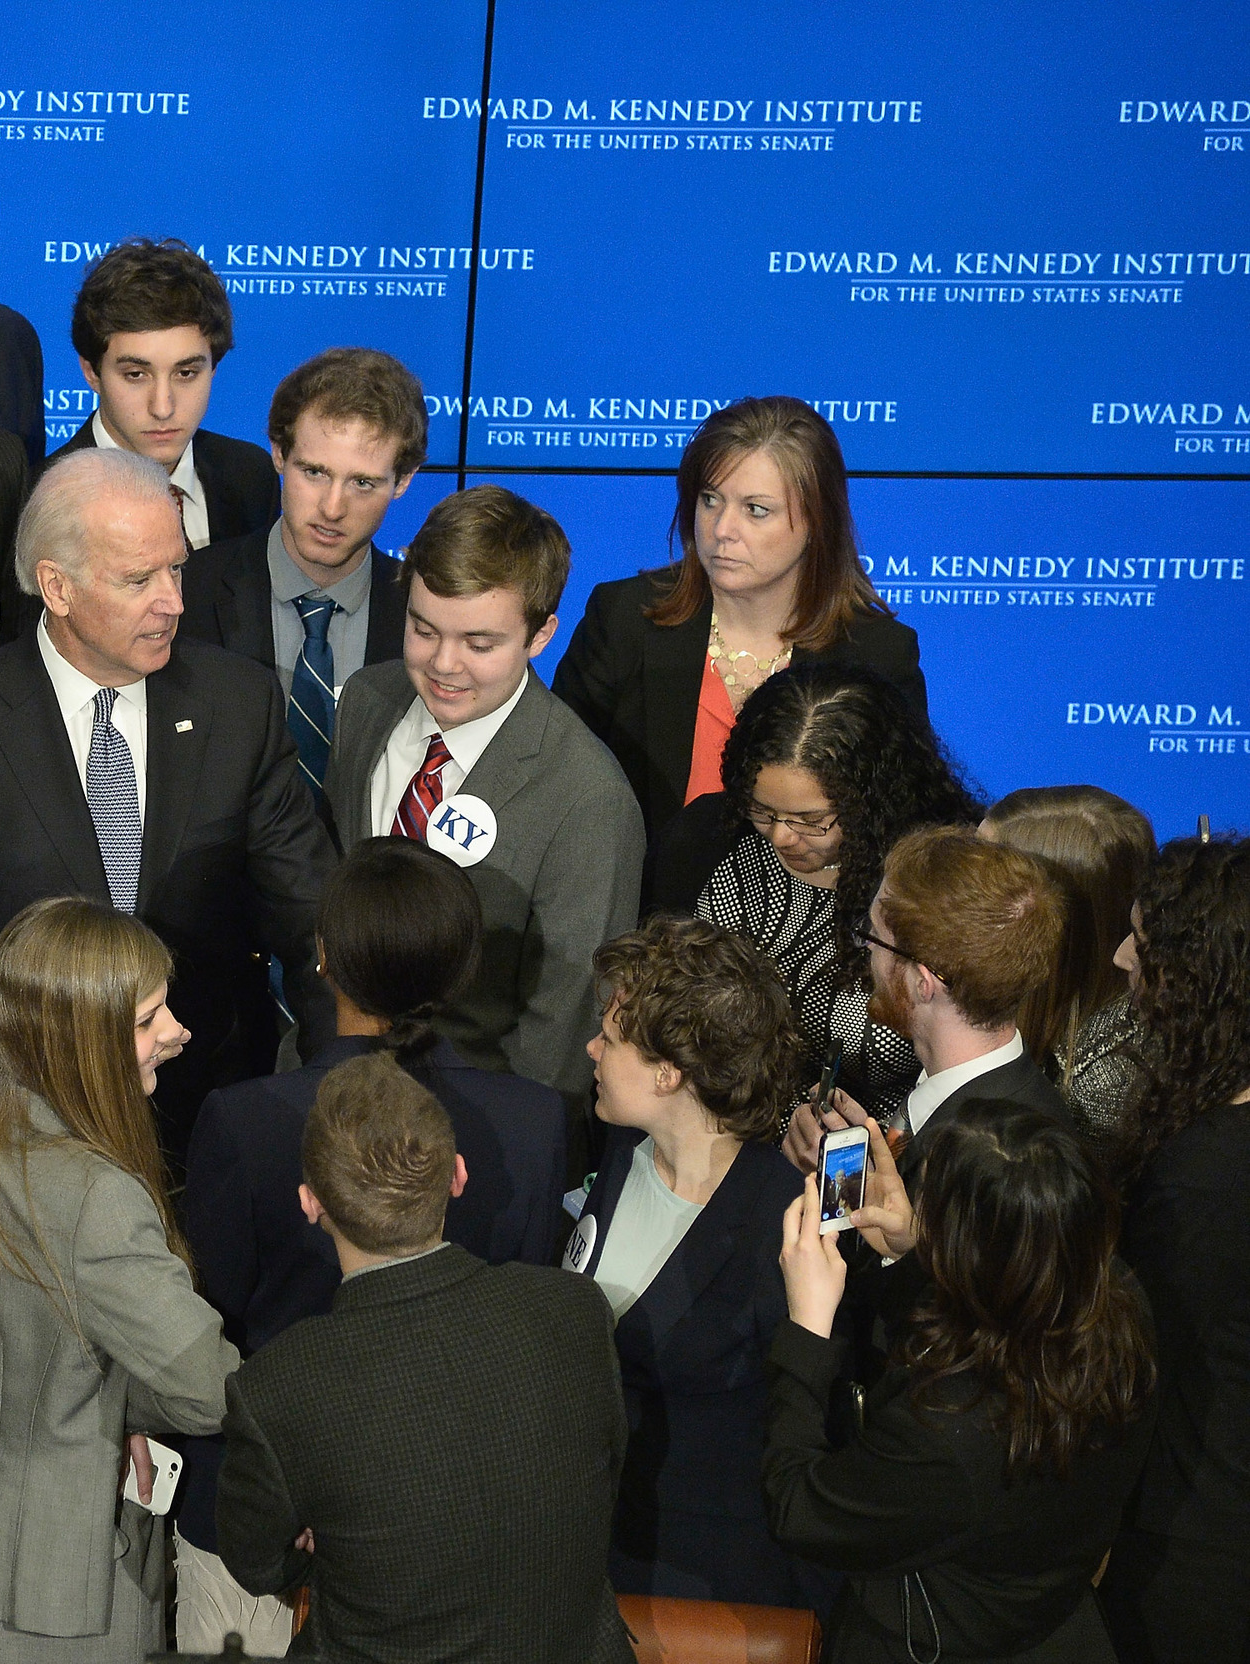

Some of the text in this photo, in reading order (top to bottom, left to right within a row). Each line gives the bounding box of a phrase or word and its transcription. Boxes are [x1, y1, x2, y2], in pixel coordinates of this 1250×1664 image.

[35, 90, 190, 115] INSTITUTE
[423, 97, 922, 123] EDWARD M. KENNEDY INSTITUTE
[1119, 100, 1250, 123] EDWARD
[32, 125, 104, 142] SENATE
[506, 133, 835, 152] FOR THE UNITED STATES SENATE
[1203, 136, 1244, 152] FOR
[226, 244, 367, 268] KENNEDY
[378, 246, 535, 270] INSTITUTE
[768, 251, 898, 274] EDWARD
[909, 252, 942, 274] M.
[955, 252, 1101, 275] KENNEDY
[301, 280, 368, 296] STATES
[374, 280, 448, 297] SENATE
[850, 286, 1184, 304] FOR THE UNITED STATES SENATE
[544, 397, 576, 419] M.
[1091, 403, 1223, 425] EDWARD
[487, 430, 526, 446] FOR
[532, 431, 572, 446] THE
[579, 431, 658, 448] UNITED
[1174, 438, 1214, 453] FOR
[885, 555, 918, 577] M.
[931, 555, 1075, 578] KENNEDY
[1086, 557, 1245, 580] INSTITUTE
[920, 589, 1000, 605] UNITED
[1007, 590, 1075, 606] STATES
[1081, 590, 1157, 607] SENATE
[1066, 703, 1241, 726] EDWARD M.
[1149, 737, 1189, 753] FOR
[1195, 737, 1237, 754] THE
[433, 804, 489, 852] KY
